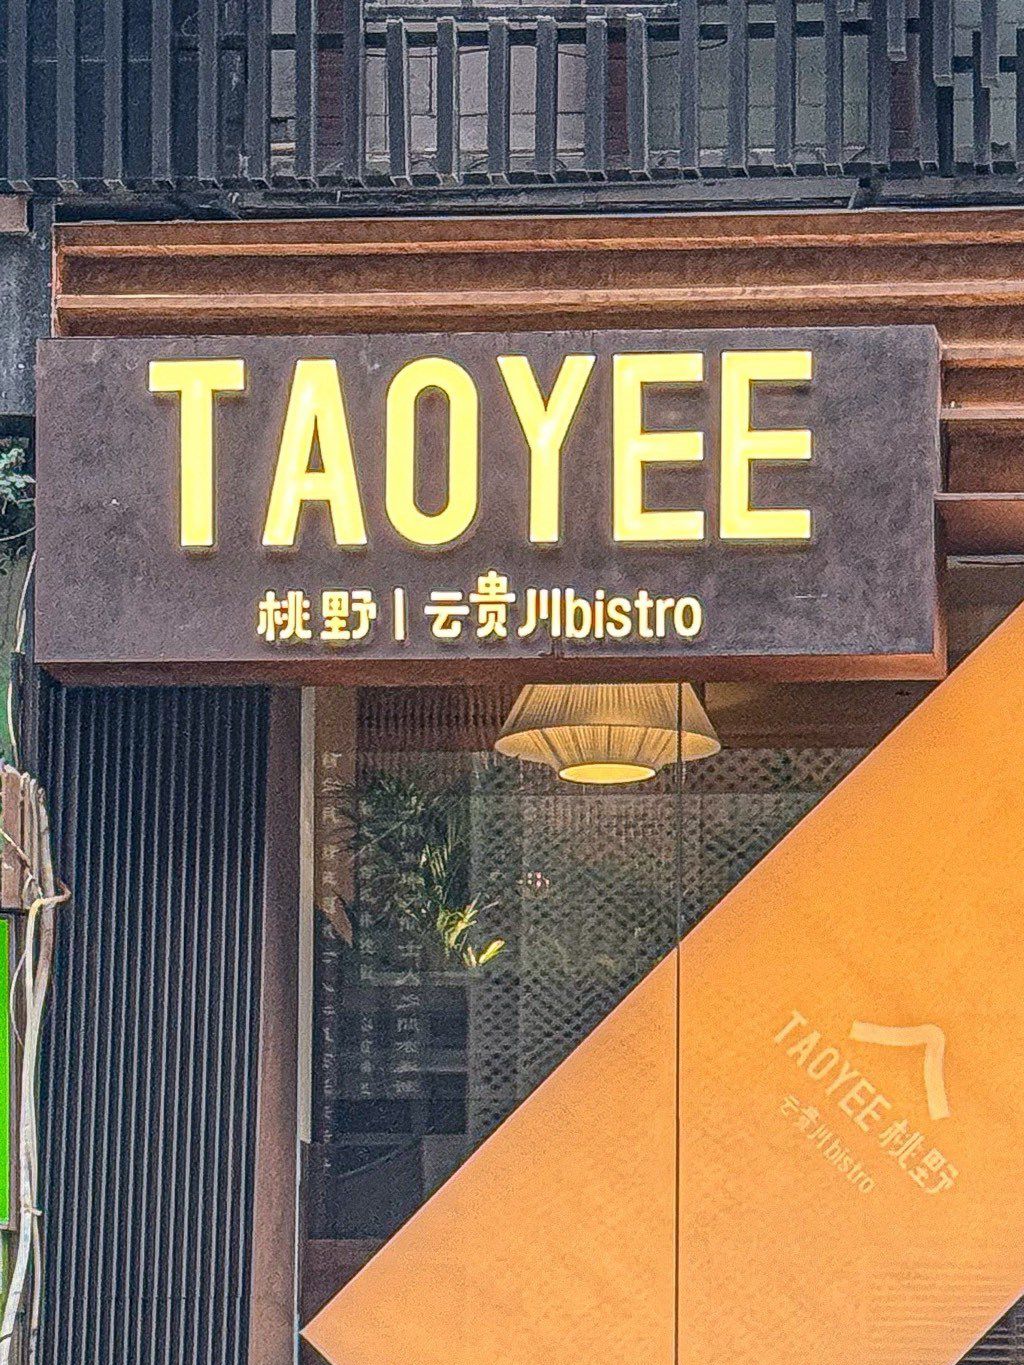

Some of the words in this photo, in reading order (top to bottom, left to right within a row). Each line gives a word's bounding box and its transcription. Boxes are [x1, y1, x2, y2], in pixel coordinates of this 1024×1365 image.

[148, 350, 814, 547] TAOYEE
[257, 589, 377, 641] 桃野
[772, 1009, 893, 1134] TAOYEE
[879, 1118, 960, 1195] 桃野
